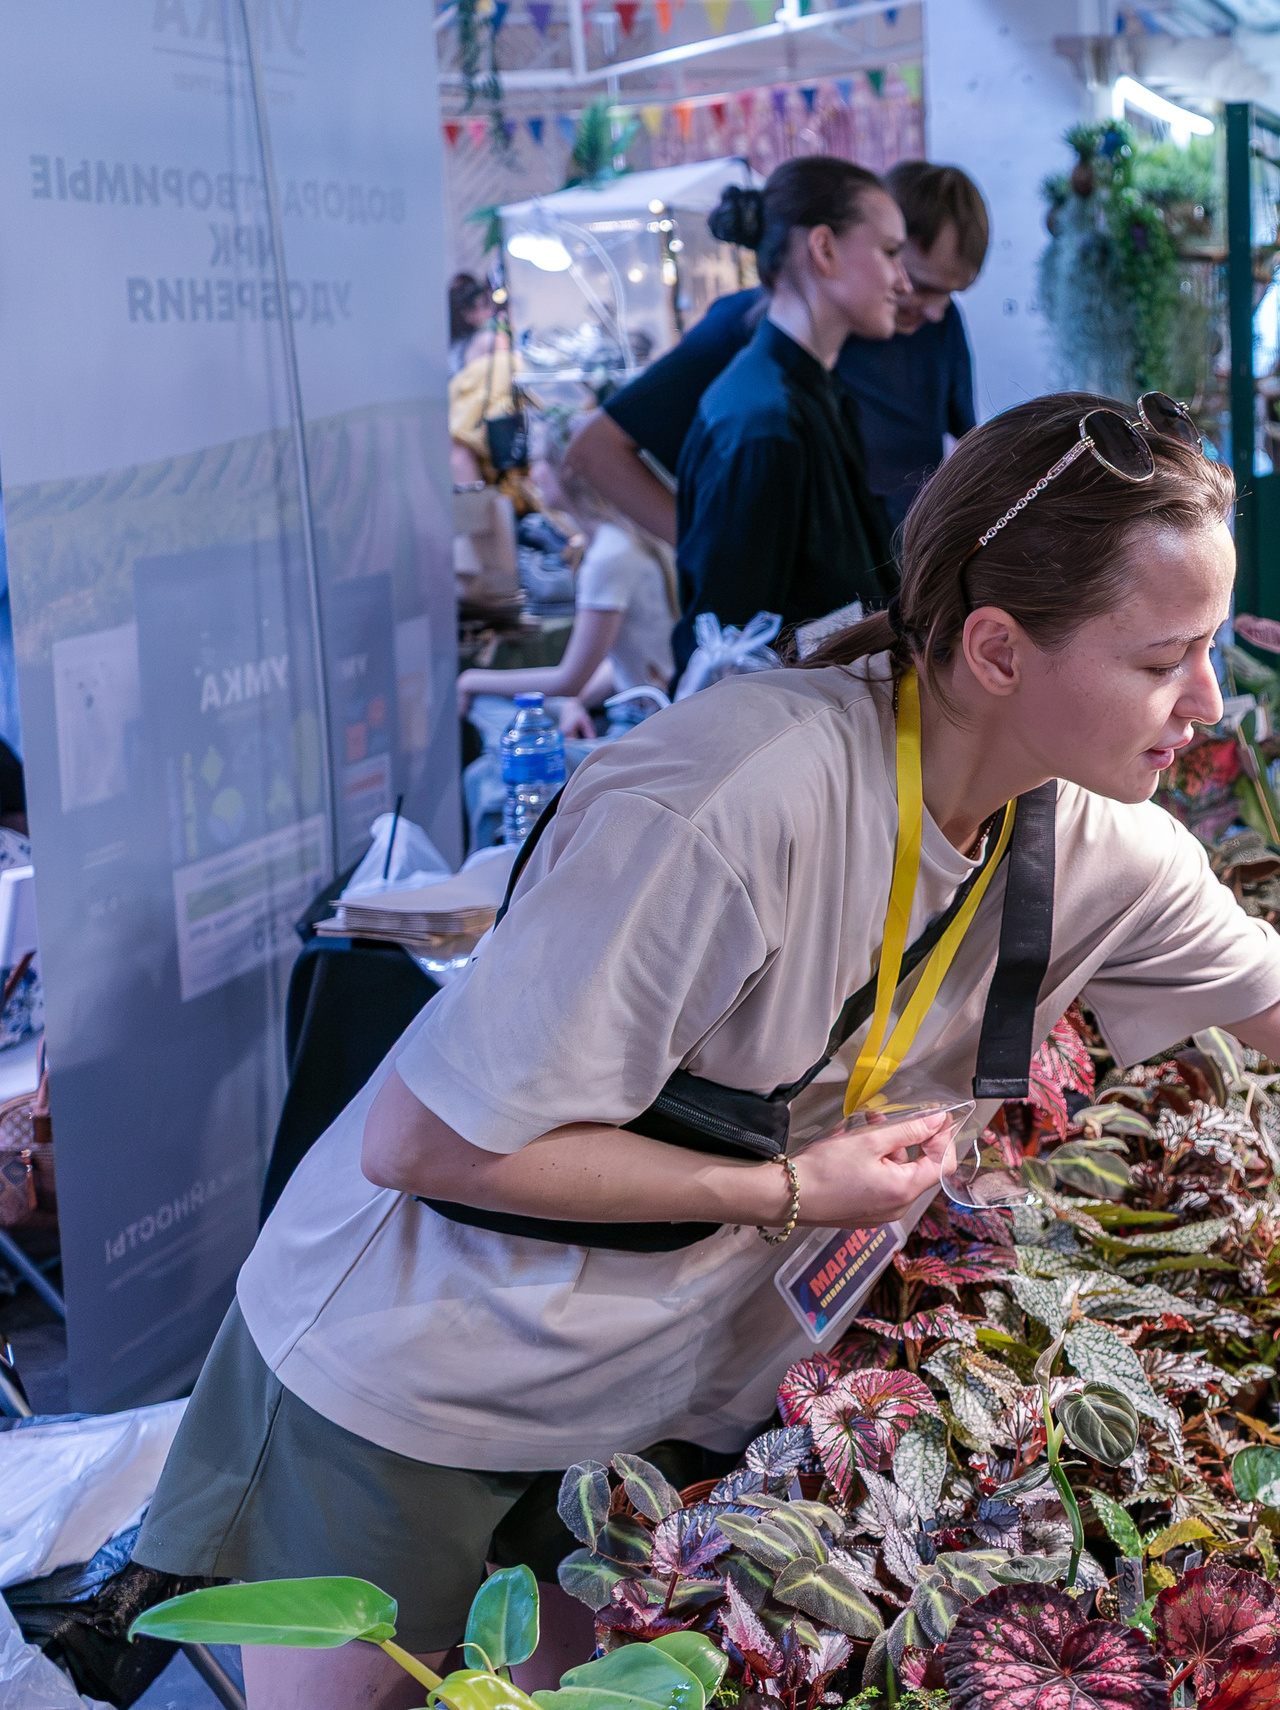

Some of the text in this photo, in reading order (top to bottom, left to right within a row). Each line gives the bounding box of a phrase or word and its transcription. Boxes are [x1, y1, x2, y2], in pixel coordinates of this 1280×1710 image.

[809, 1228, 878, 1298] МАРКЕ
[820, 1229, 887, 1309] URBAN JUNGLE FEST
